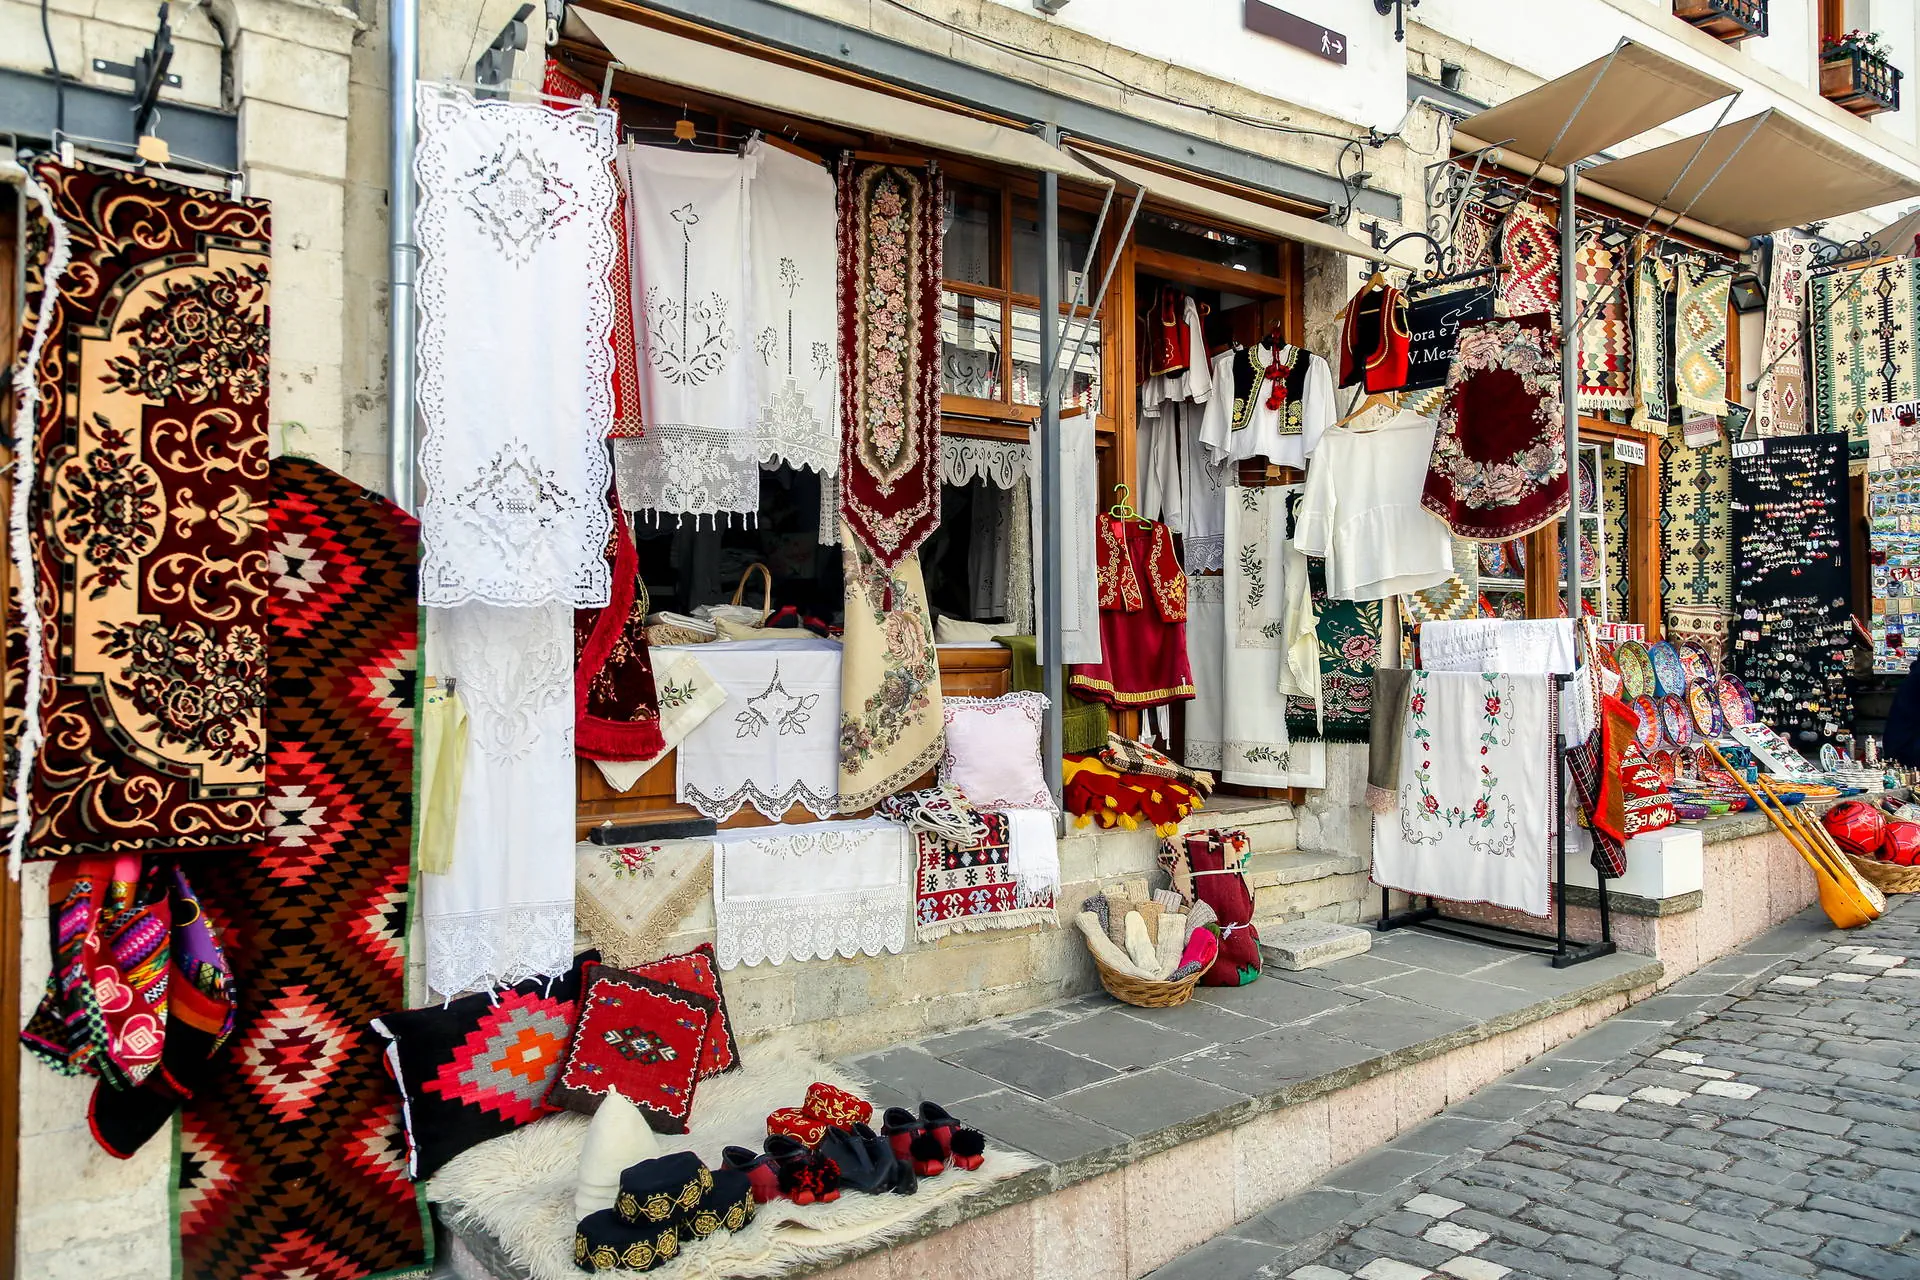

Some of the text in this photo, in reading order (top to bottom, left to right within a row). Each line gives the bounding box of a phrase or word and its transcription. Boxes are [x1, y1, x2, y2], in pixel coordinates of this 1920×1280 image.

[1439, 327, 1447, 337] e
[1423, 346, 1454, 363] Mez
[1616, 443, 1643, 461] SILVER 925
